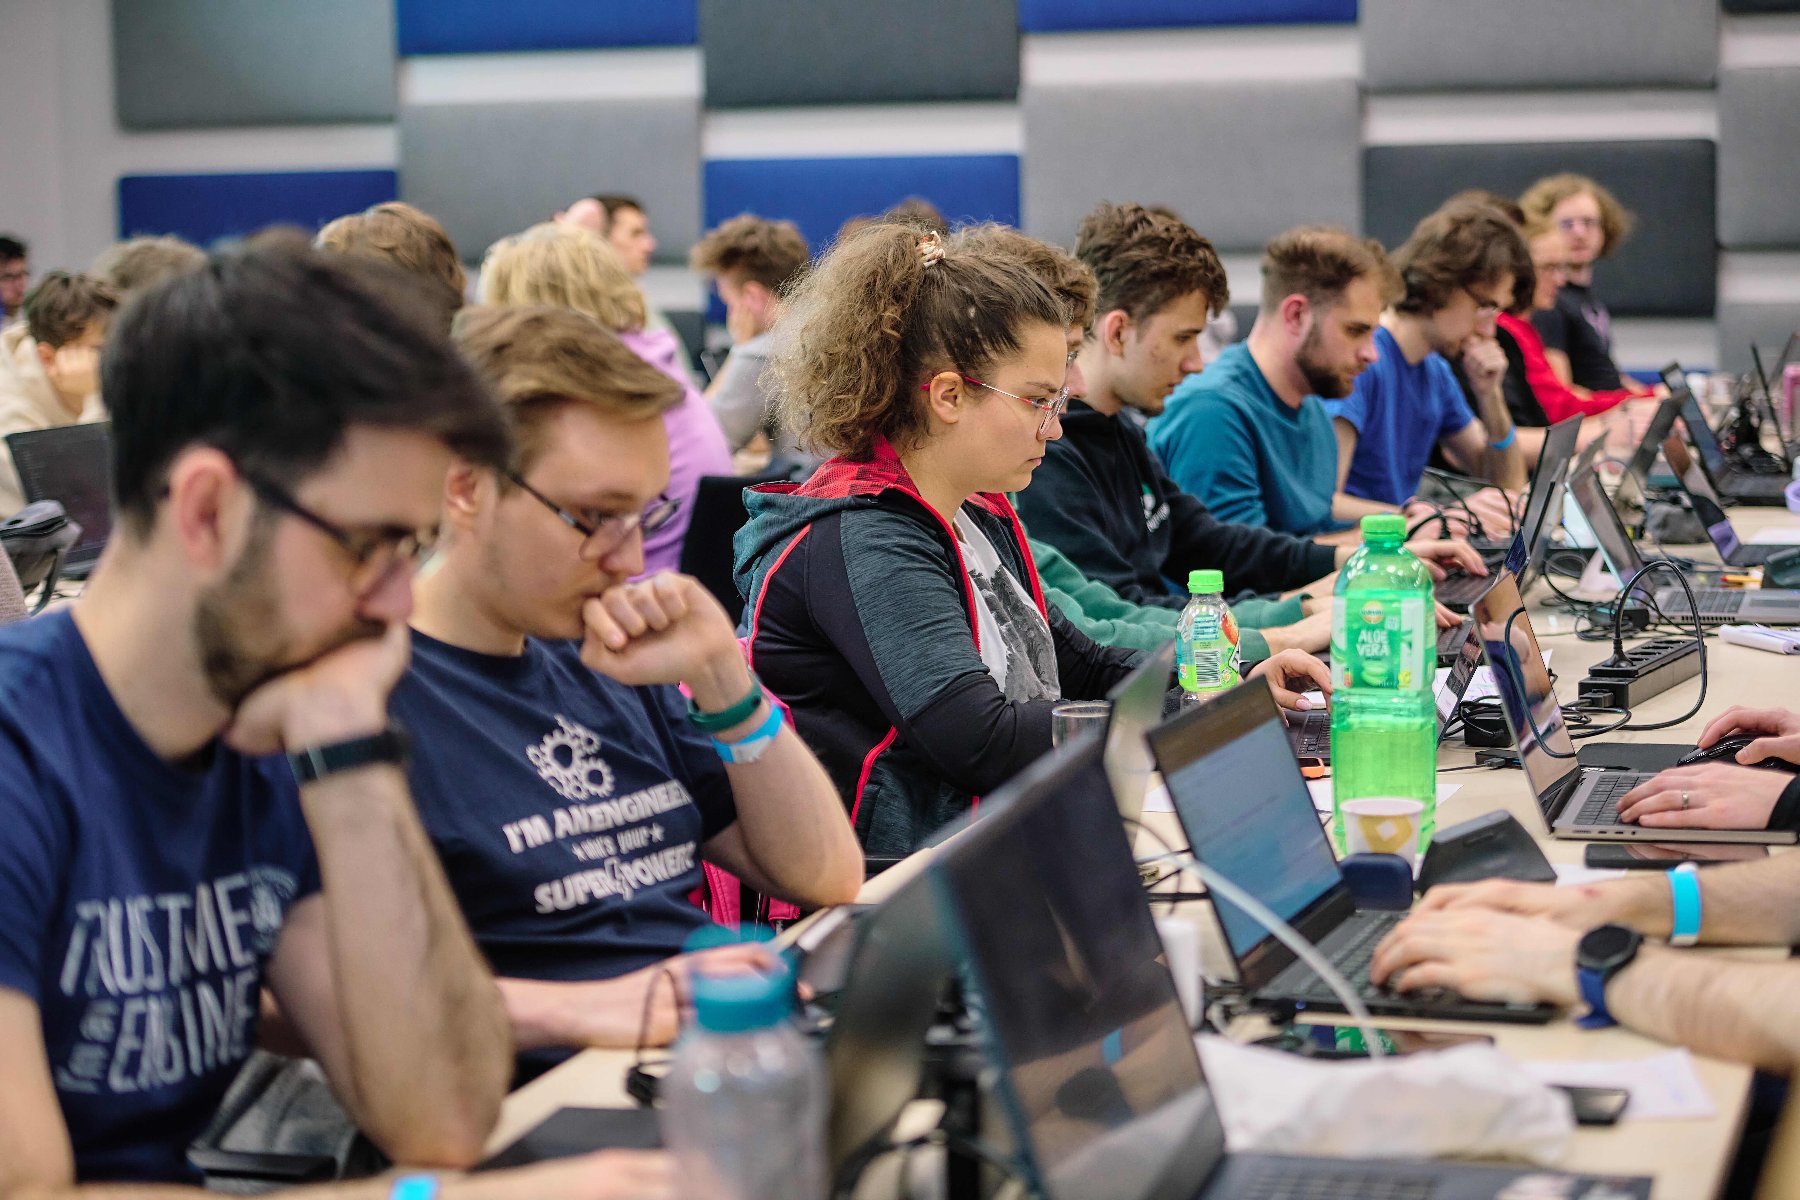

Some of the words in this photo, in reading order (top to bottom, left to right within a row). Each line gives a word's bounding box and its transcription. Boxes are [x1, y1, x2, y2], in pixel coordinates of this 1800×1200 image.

[1356, 642, 1390, 656] VERA
[1357, 629, 1388, 643] ALOE
[502, 815, 553, 854] I'M
[534, 868, 618, 914] SUPER
